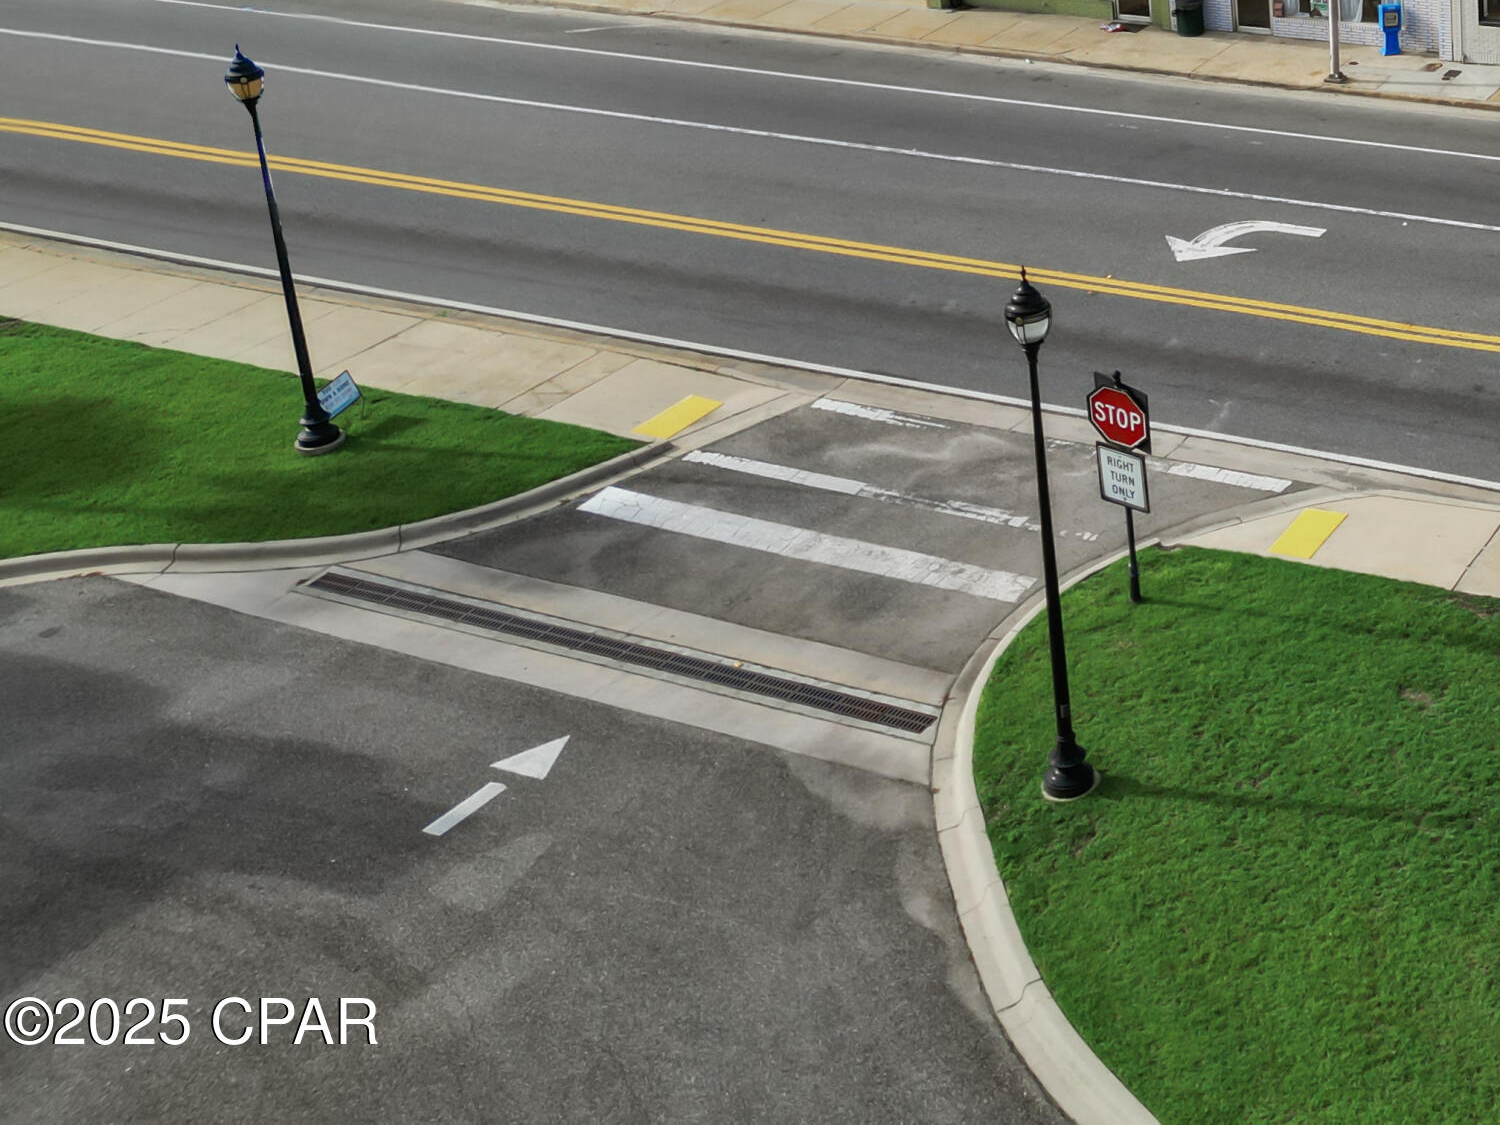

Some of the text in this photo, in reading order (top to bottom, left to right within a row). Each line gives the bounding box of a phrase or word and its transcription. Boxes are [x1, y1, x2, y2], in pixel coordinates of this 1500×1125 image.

[1094, 401, 1141, 432] STOP
[1106, 455, 1134, 473] RIGHT
[1110, 470, 1135, 487] TURN
[1111, 484, 1135, 499] ONLY
